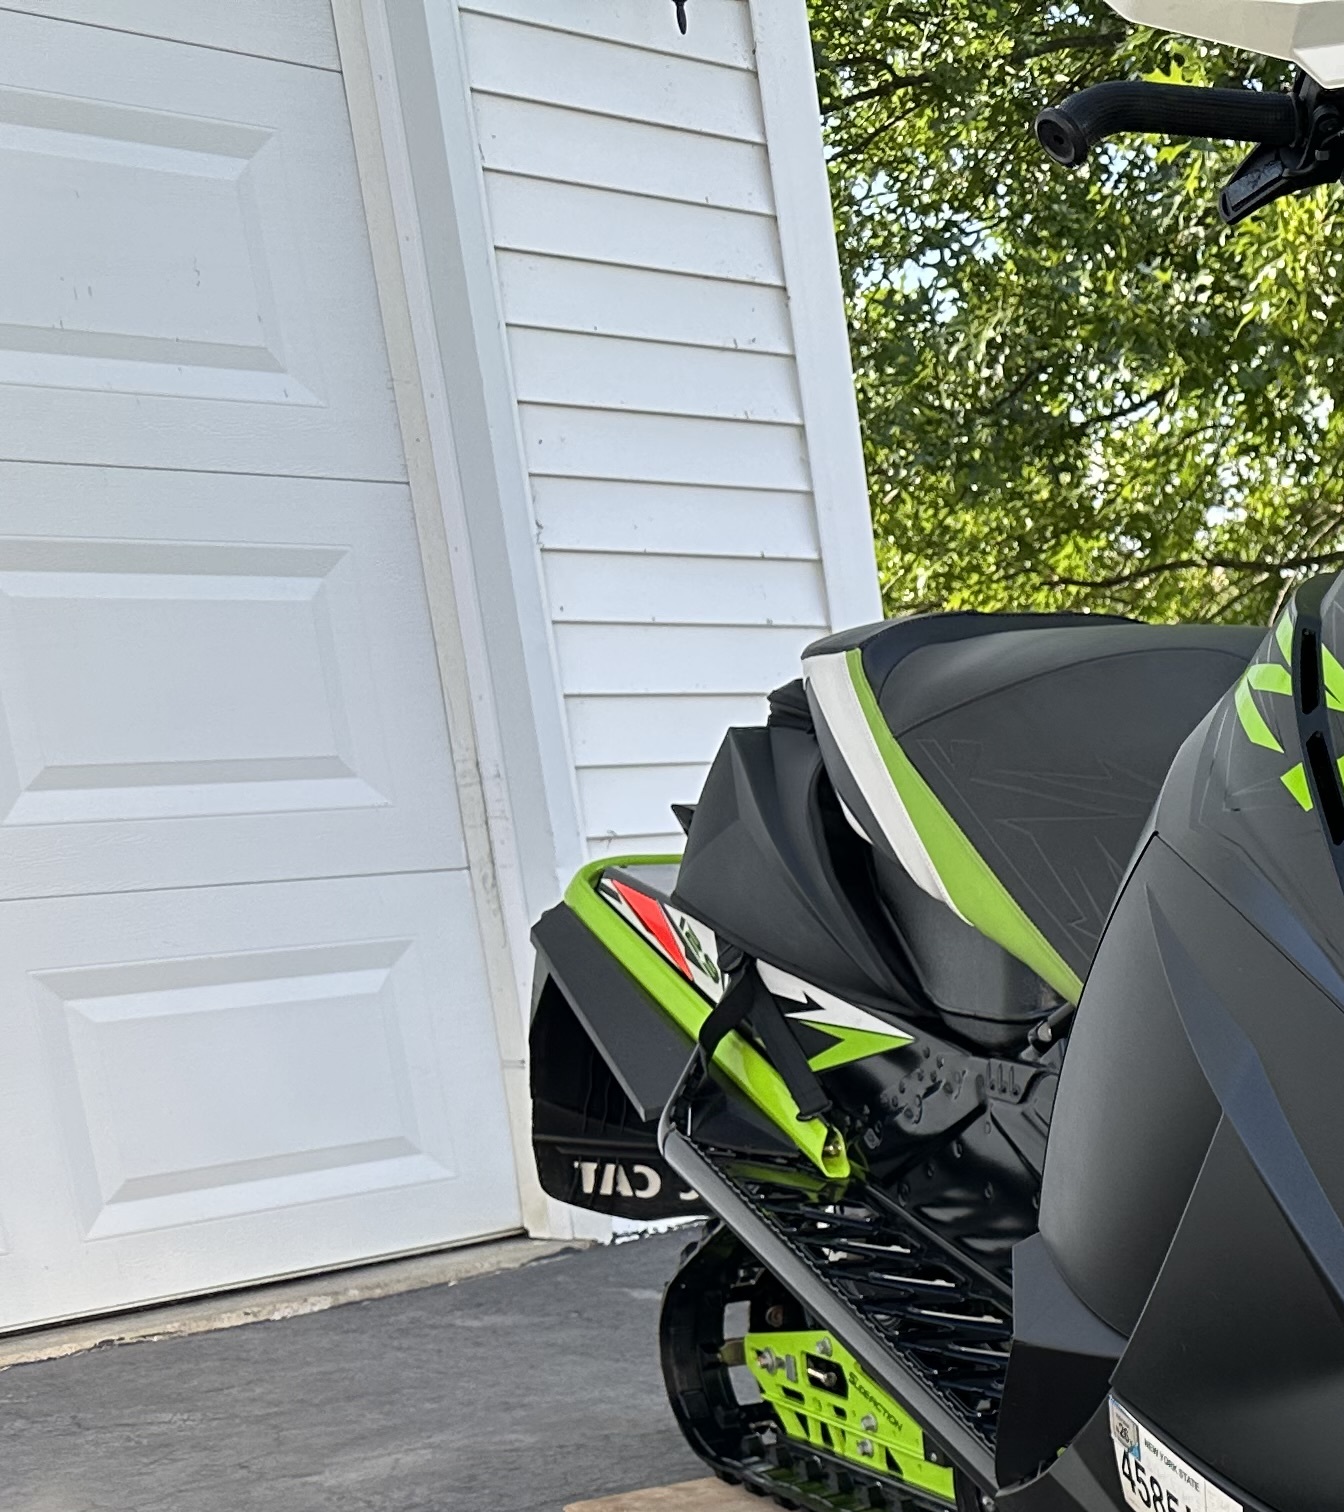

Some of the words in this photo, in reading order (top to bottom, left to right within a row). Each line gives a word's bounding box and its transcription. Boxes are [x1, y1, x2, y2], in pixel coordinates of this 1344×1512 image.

[1144, 1438, 1158, 1458] NEW
[1160, 1453, 1178, 1473] YORK
[1179, 1469, 1200, 1492] STATE
